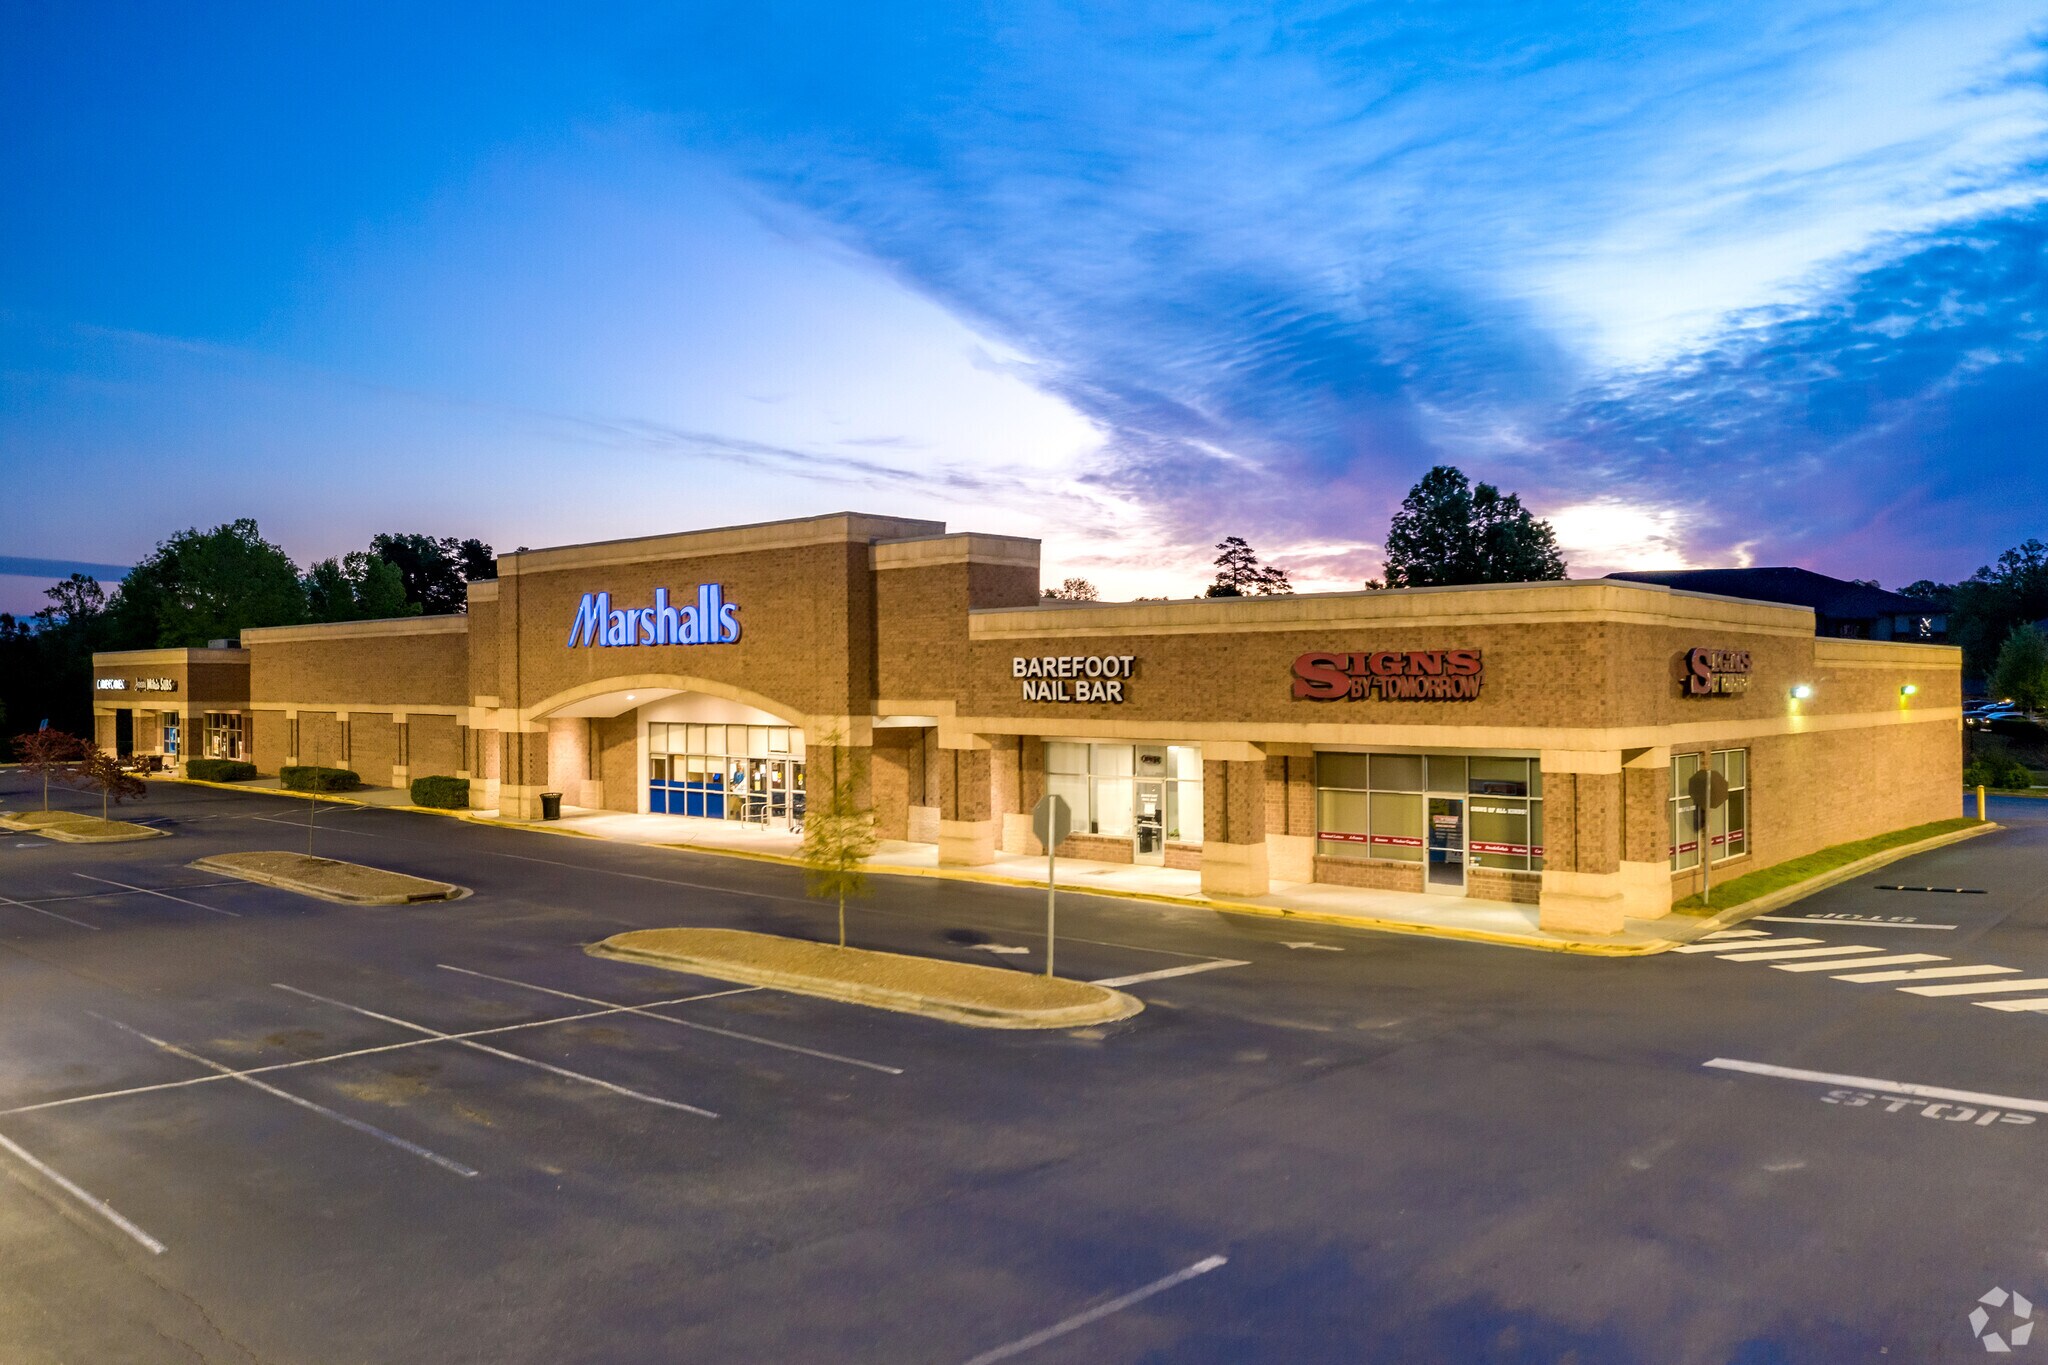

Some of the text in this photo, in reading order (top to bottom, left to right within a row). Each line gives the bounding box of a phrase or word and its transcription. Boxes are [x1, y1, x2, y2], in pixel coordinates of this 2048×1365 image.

[567, 583, 740, 647] Marshalls
[1012, 656, 1135, 678] BAREFOOT
[1293, 650, 1482, 699] SIGNS
[1023, 680, 1123, 701] NAIL BAR
[1350, 675, 1480, 698] BY TOMORROW
[1820, 1090, 2037, 1126] STOP
